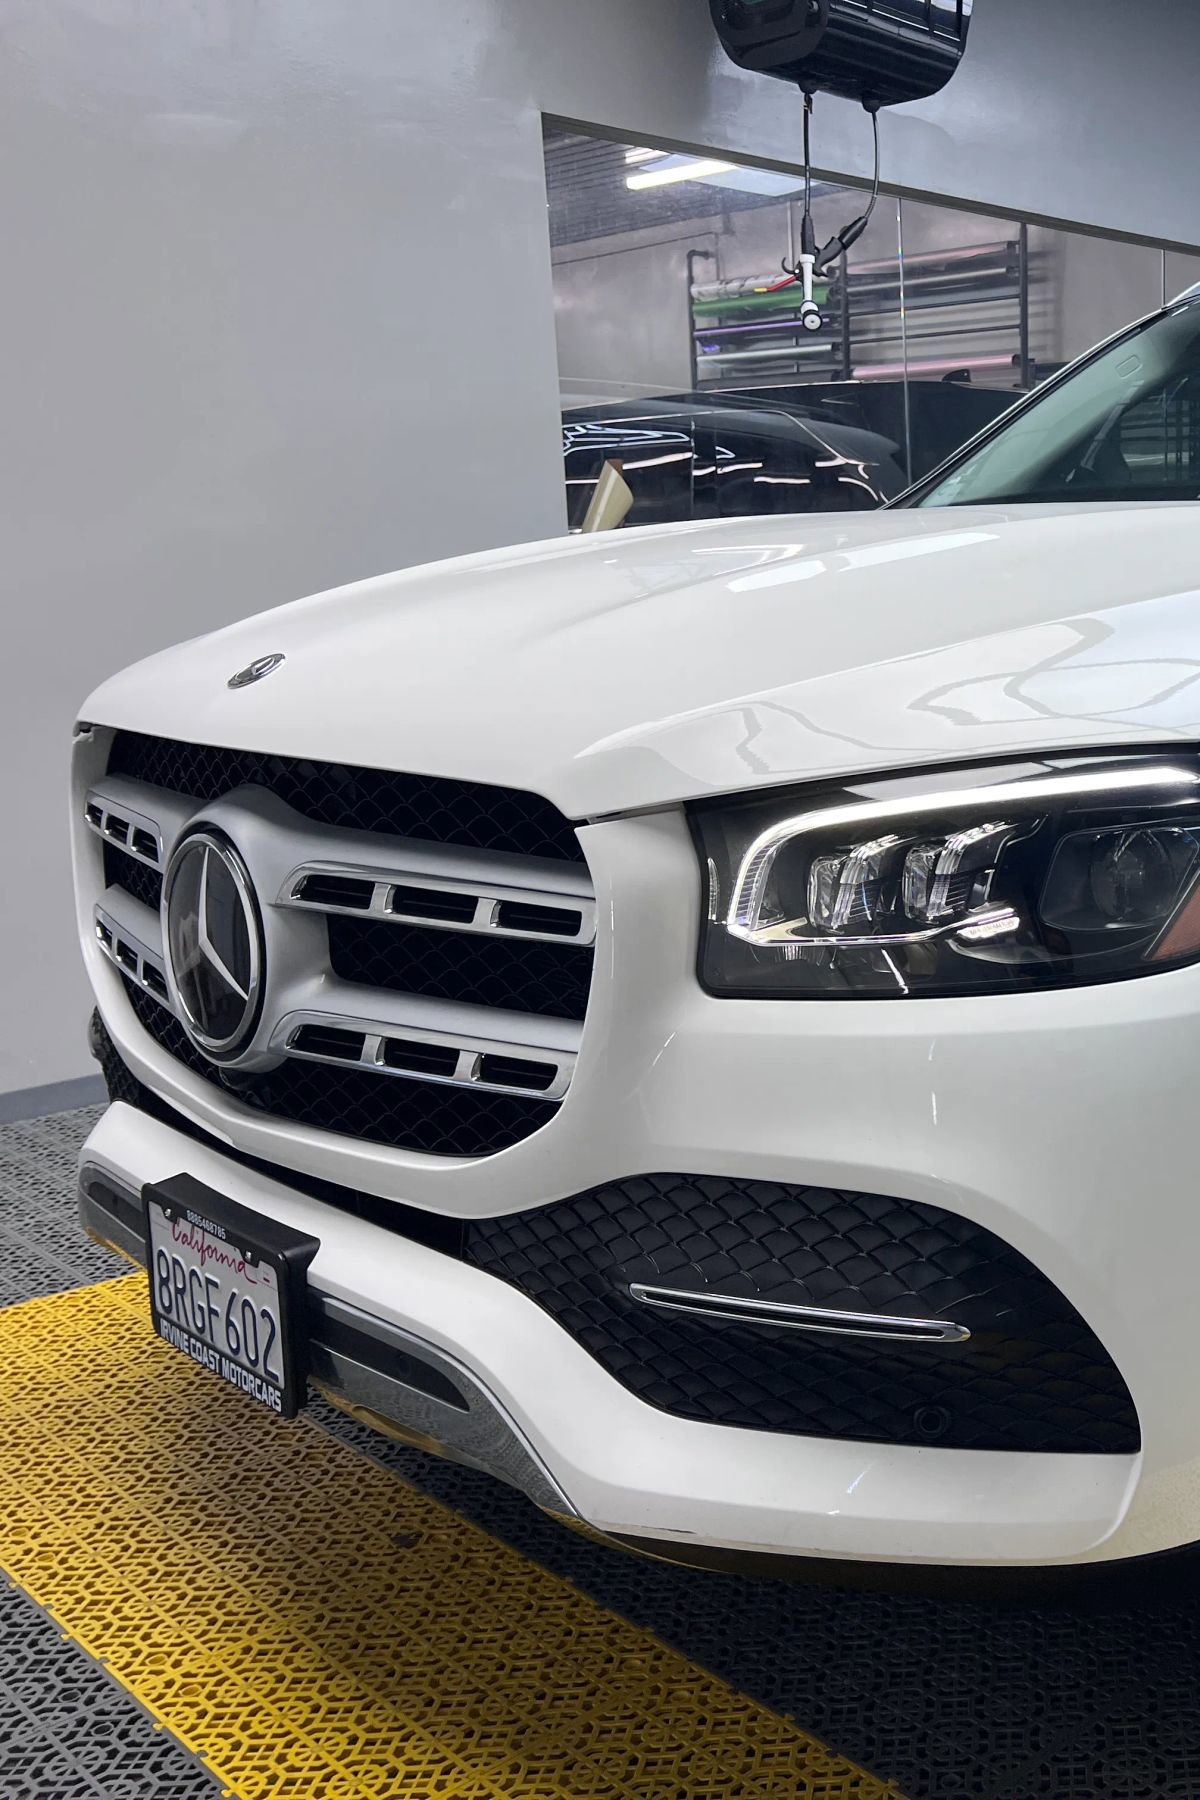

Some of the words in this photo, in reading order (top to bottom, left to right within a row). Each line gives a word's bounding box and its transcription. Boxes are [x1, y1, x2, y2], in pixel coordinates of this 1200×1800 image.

[172, 1217, 258, 1285] California
[160, 1318, 190, 1354] IRVINE
[190, 1337, 220, 1373] COAST
[221, 1357, 282, 1413] MOTORCARS
